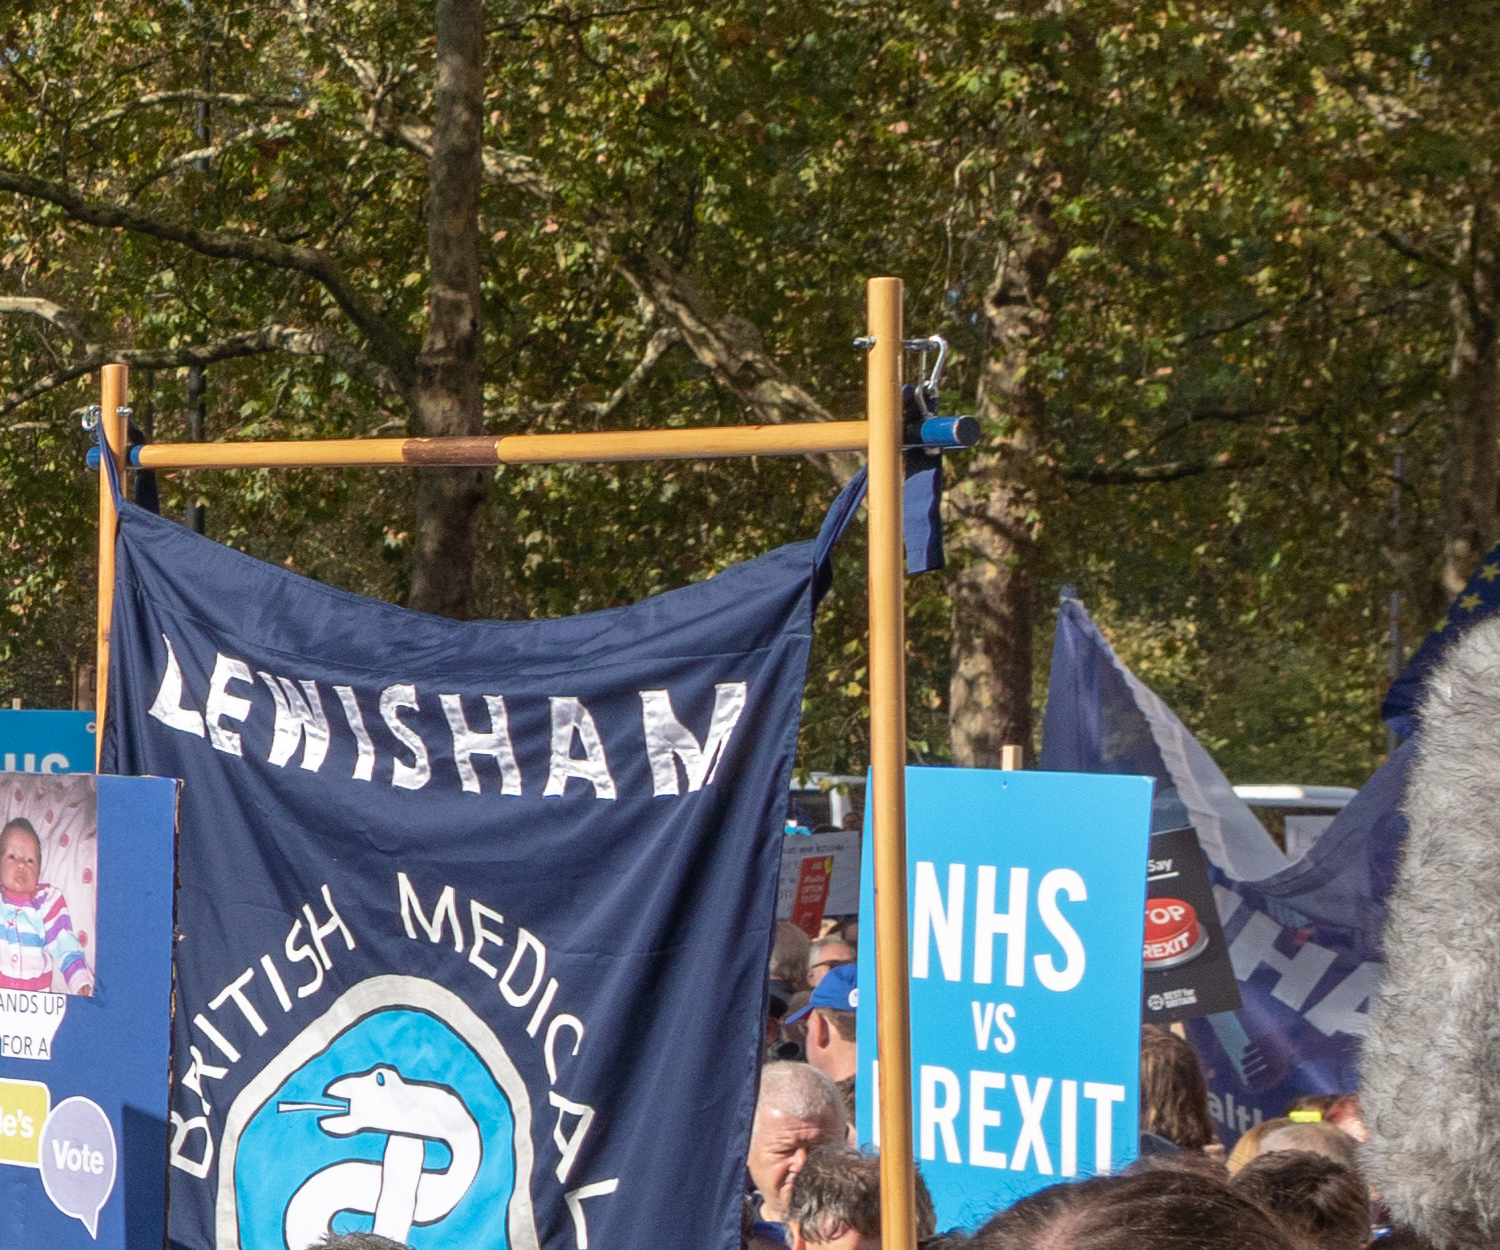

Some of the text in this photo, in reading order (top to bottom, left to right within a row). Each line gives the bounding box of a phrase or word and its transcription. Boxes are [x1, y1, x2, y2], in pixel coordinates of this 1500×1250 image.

[148, 634, 748, 801] LEWISHAM
[912, 860, 1089, 993] NHS
[1142, 932, 1190, 958] REXIT
[2, 1035, 50, 1058] FOR A
[44, 994, 66, 1017] UP
[170, 884, 356, 1180] BRITISH
[970, 1001, 1016, 1054] VS
[397, 871, 620, 1250] MEDICAL
[51, 1139, 105, 1175] Vote
[919, 1064, 1126, 1177] REXIT
